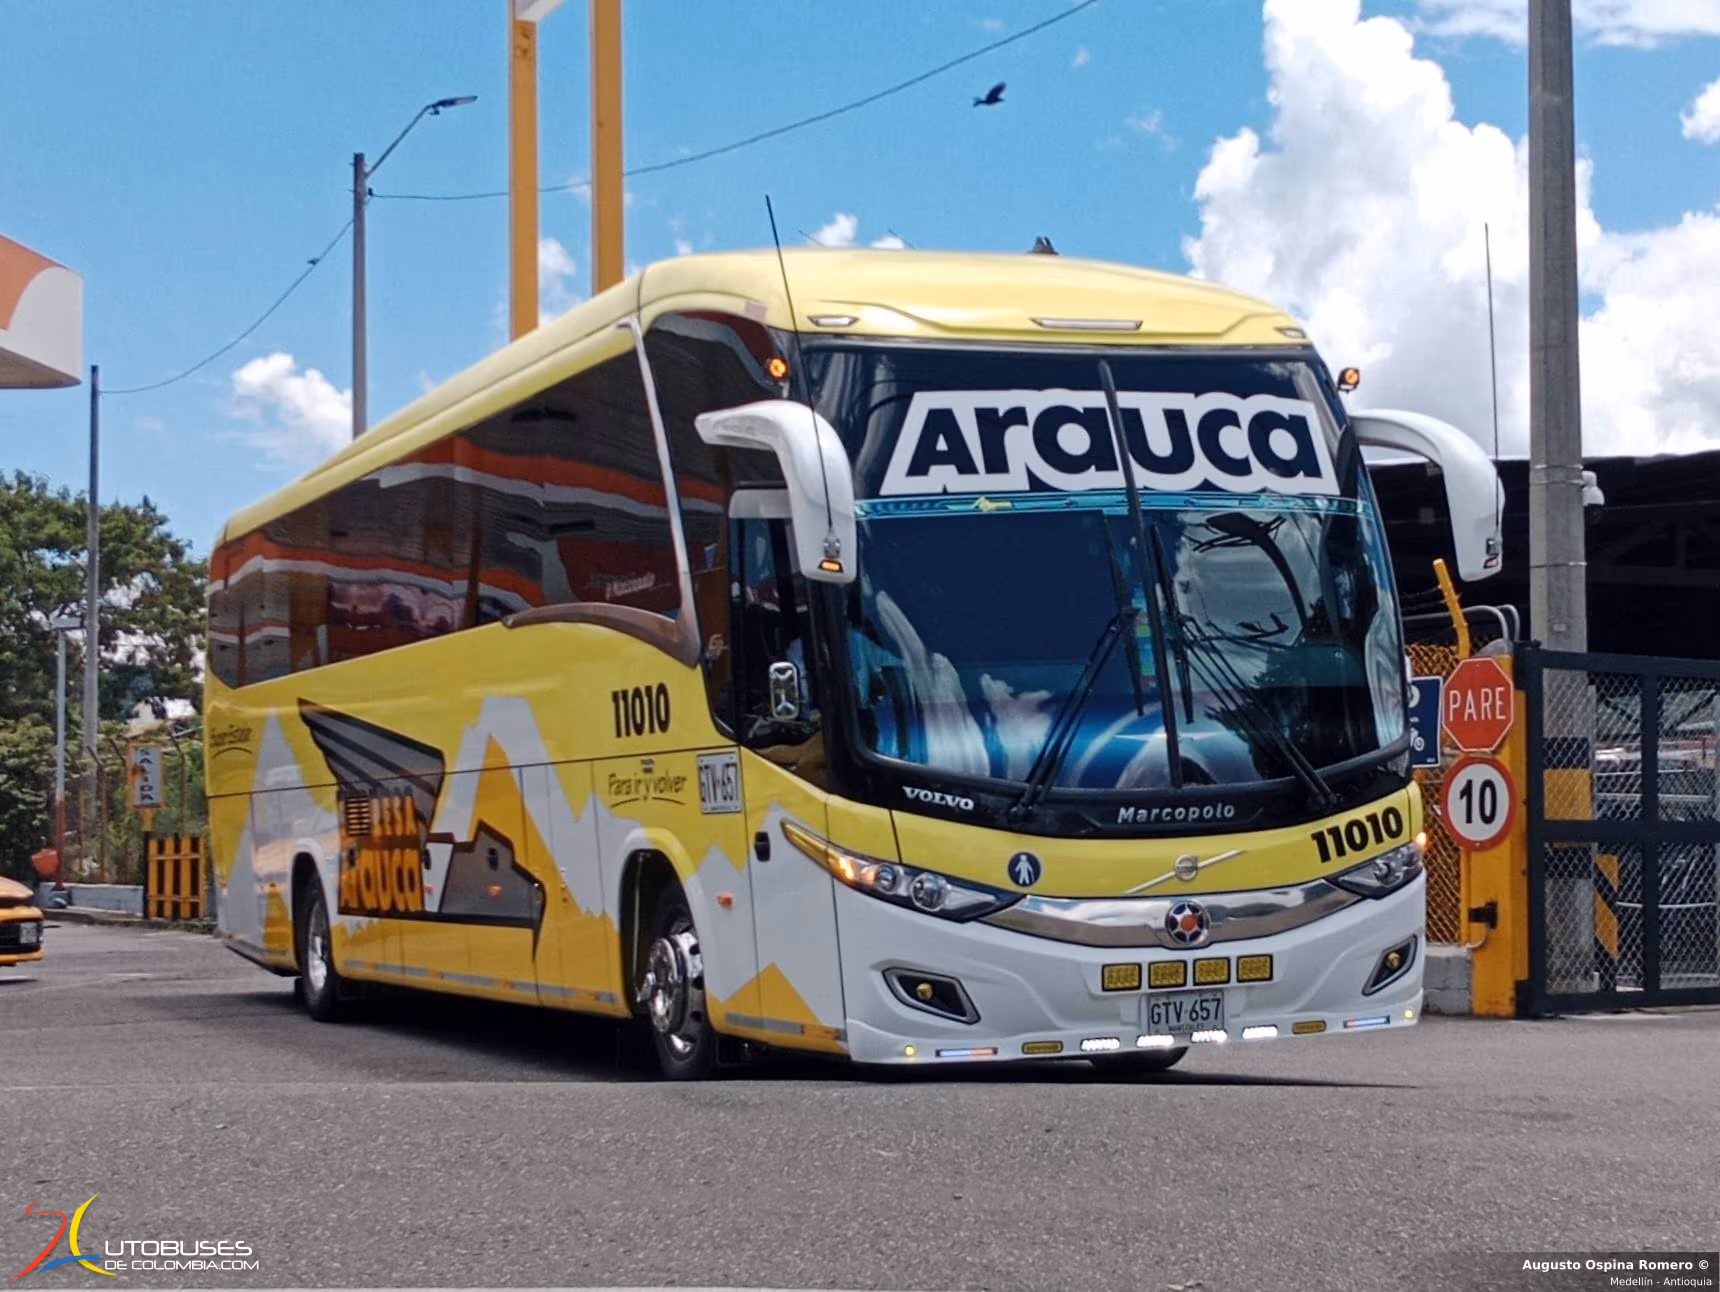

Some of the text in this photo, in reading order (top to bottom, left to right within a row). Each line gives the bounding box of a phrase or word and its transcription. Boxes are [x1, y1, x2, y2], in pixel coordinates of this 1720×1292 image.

[905, 404, 1323, 479] Arauca
[611, 682, 671, 738] 11010
[1449, 685, 1506, 722] PARE
[607, 772, 632, 796] Para
[643, 777, 653, 802] y
[653, 768, 687, 794] volver
[902, 786, 975, 811] VOLVO
[1459, 779, 1498, 825] 10
[1117, 802, 1236, 824] Marcopolo
[1310, 806, 1404, 863] 11010
